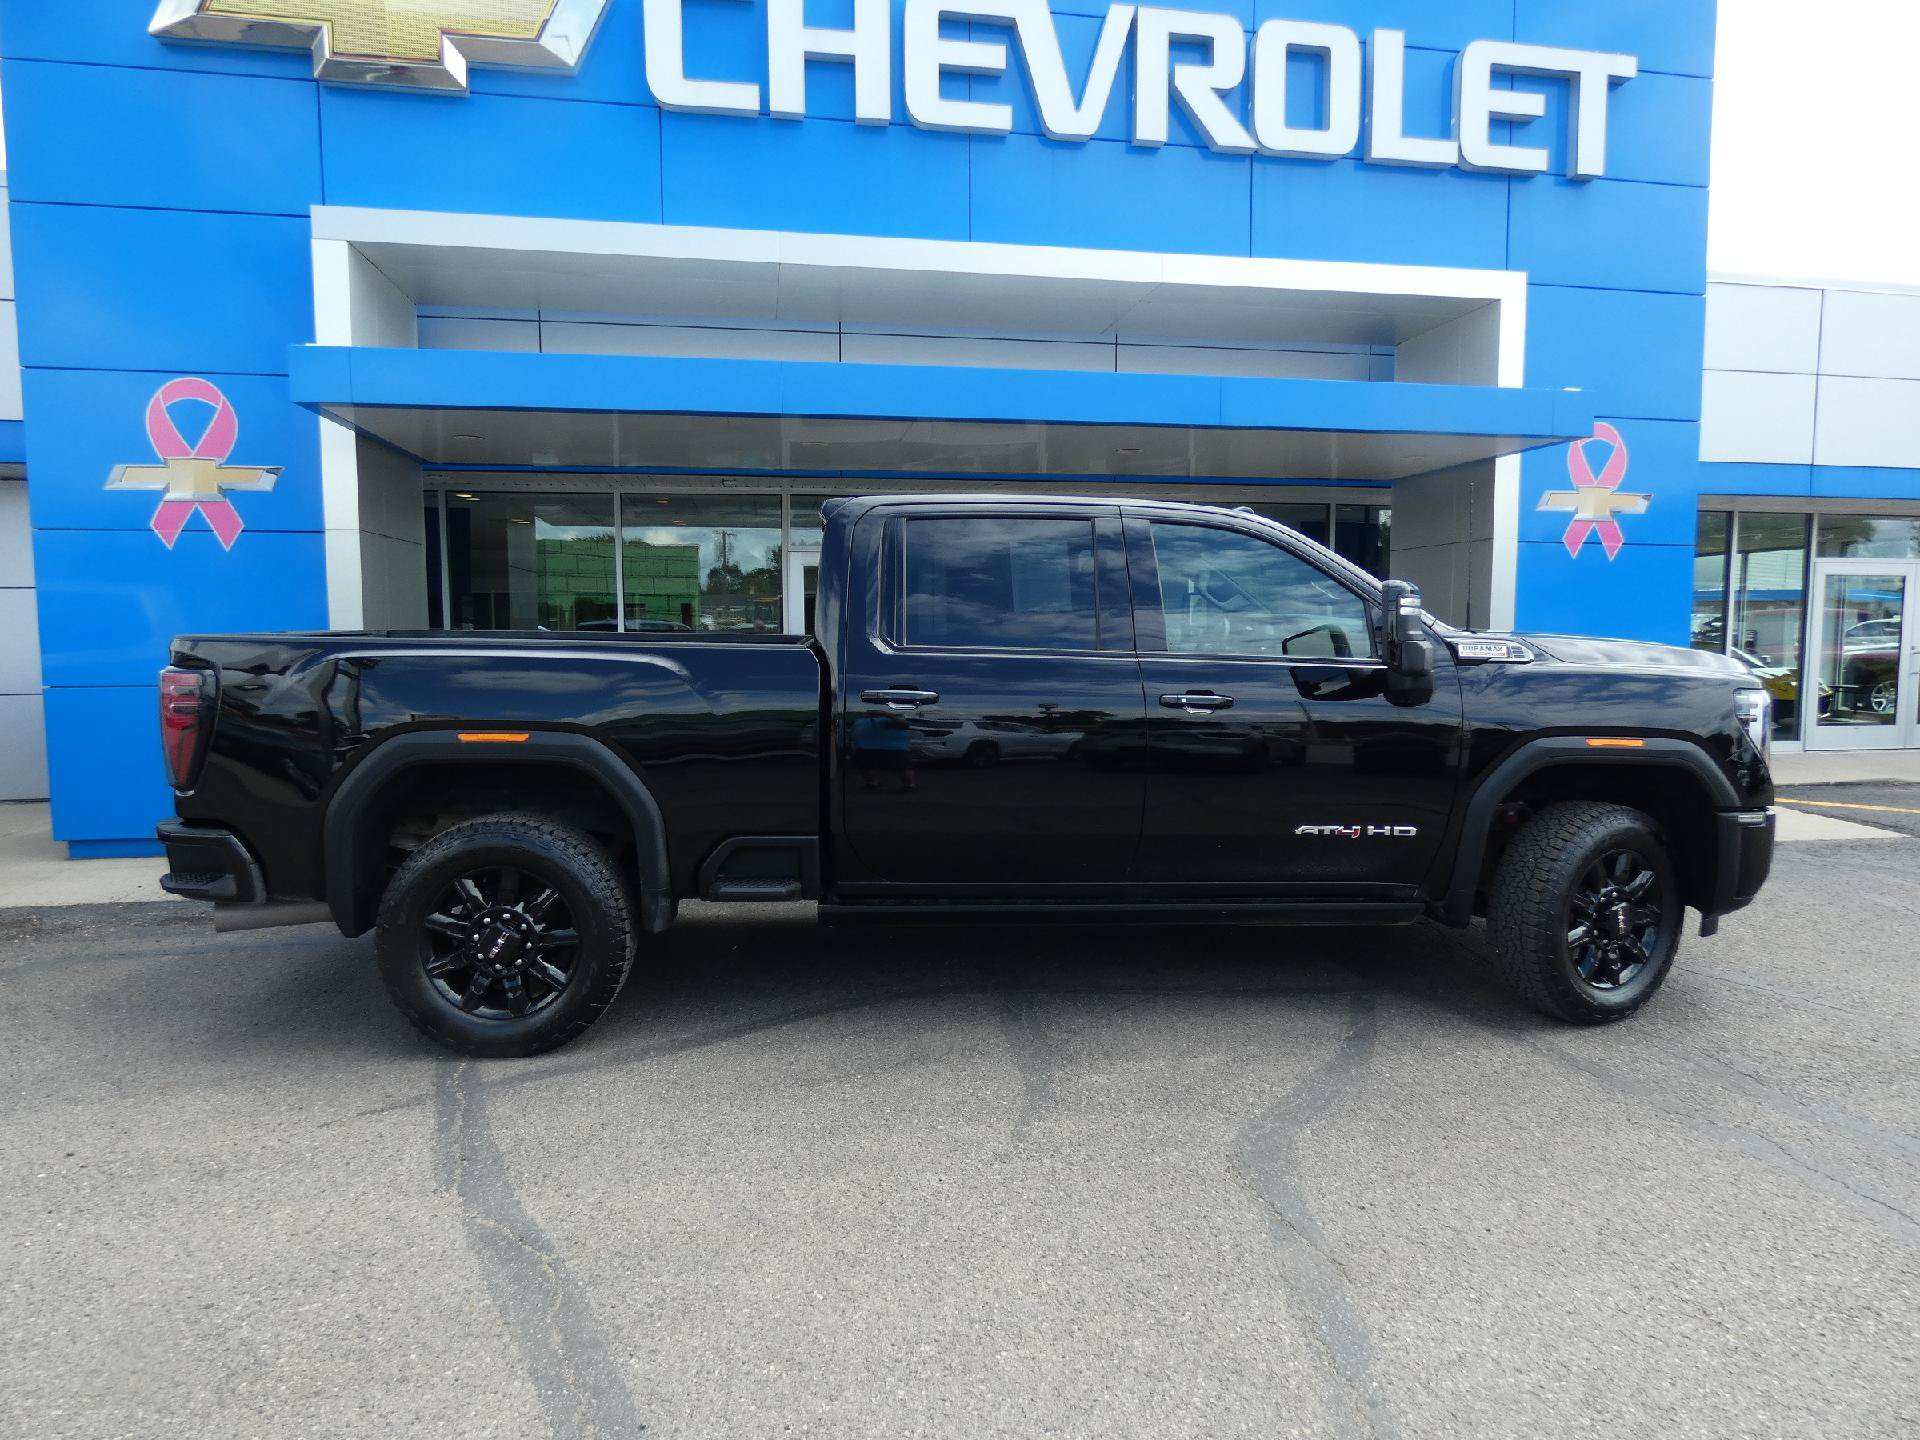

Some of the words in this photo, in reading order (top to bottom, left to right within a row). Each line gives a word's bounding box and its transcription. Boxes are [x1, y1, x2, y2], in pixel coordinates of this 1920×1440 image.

[642, 0, 1638, 181] CHEVROLET
[1367, 825, 1418, 836] HD
[488, 931, 509, 958] GMC
